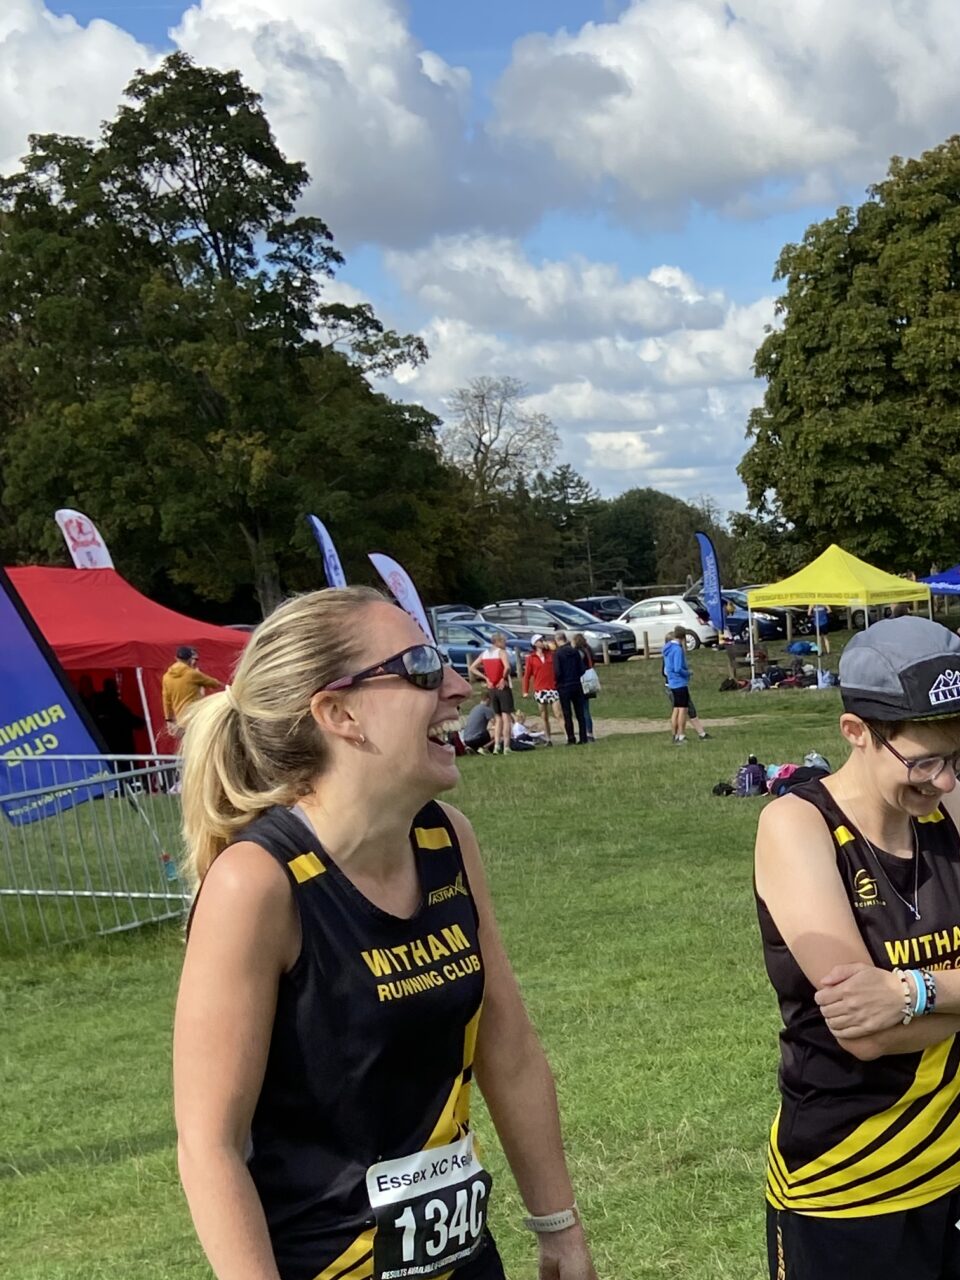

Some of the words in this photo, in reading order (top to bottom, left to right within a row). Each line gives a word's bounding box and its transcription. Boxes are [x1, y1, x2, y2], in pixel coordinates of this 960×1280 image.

[361, 923, 471, 978] WITHAM
[376, 970, 445, 1002] RUNNING
[443, 954, 481, 982] CLUB
[376, 1168, 427, 1193] Essex
[430, 1158, 449, 1179] XC
[394, 1180, 486, 1262] 134C
